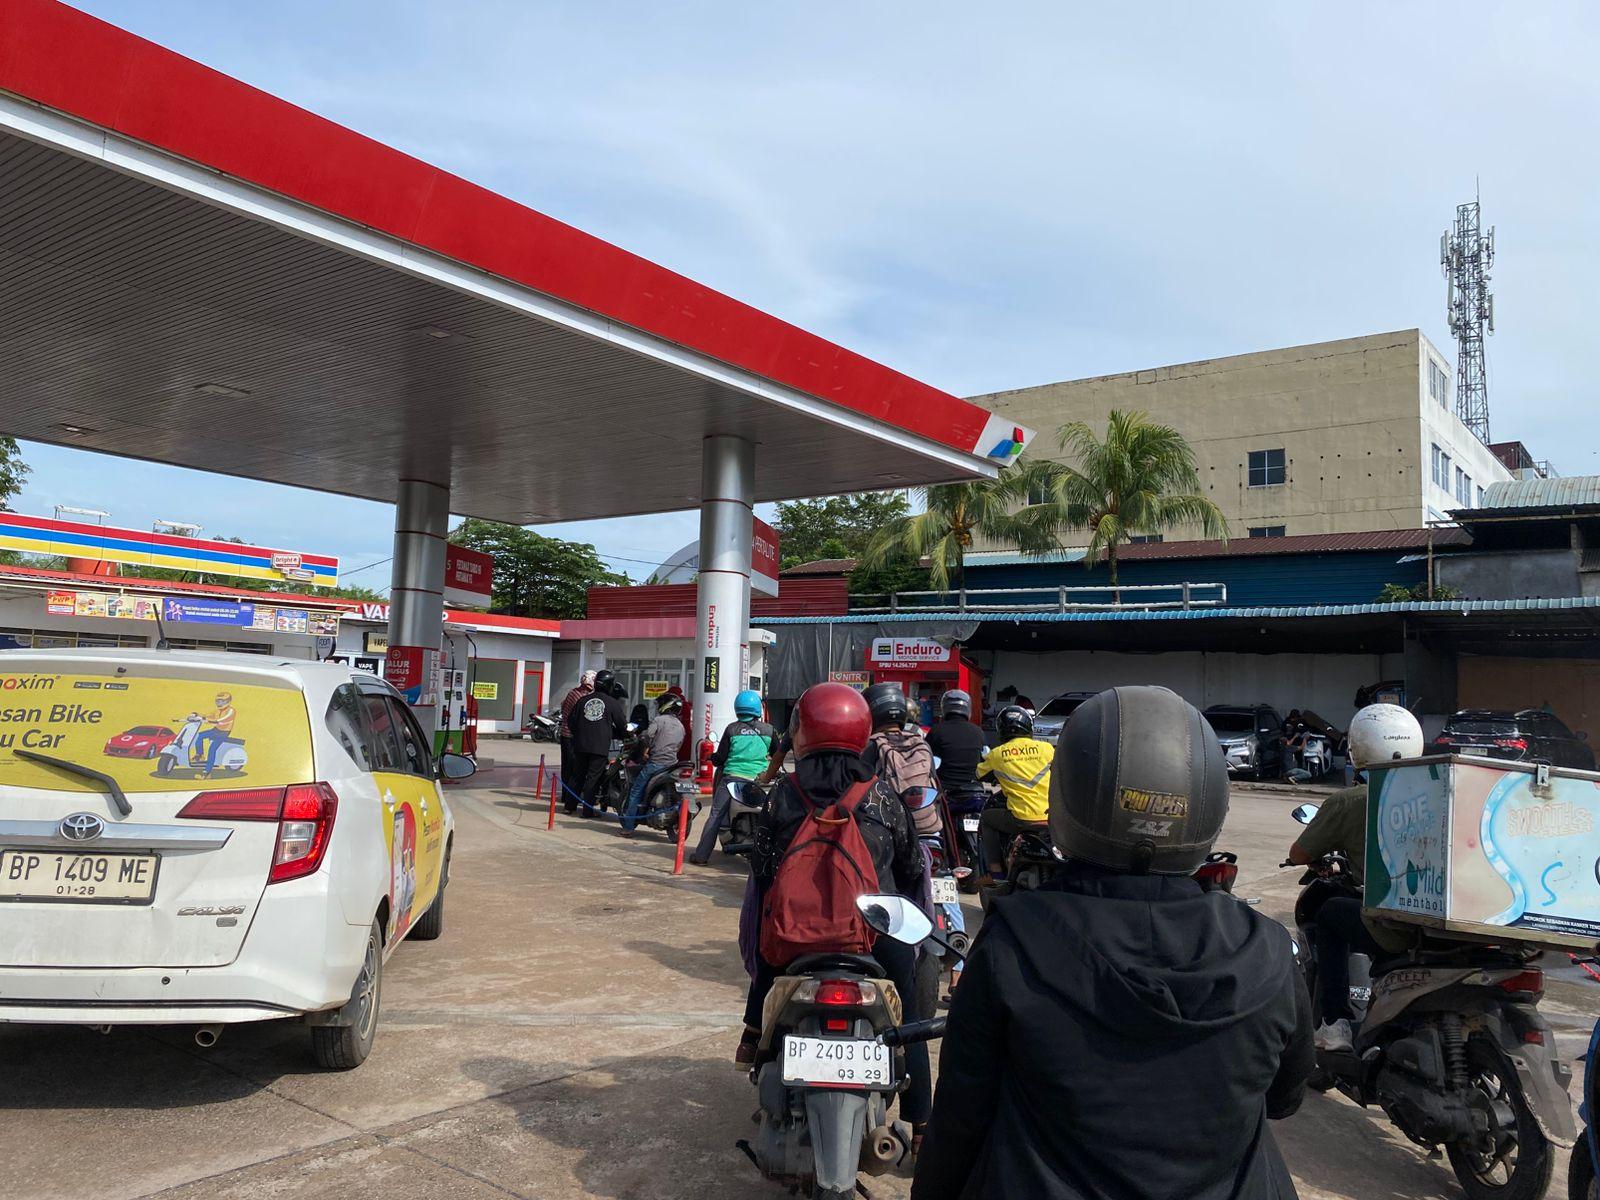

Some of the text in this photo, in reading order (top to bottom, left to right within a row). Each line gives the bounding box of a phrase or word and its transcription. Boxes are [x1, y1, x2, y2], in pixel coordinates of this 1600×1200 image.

[708, 605, 716, 649] Enduro
[896, 643, 942, 656] Enduro
[0, 675, 55, 690] axim
[48, 704, 102, 724] Bike
[22, 728, 66, 748] Car
[741, 728, 761, 736] Grab
[1002, 744, 1039, 757] maxim
[9, 855, 149, 883] BP 1409 ME
[1399, 897, 1443, 912] menthol
[789, 1041, 807, 1058] BP
[816, 1043, 854, 1060] 2403
[865, 1070, 881, 1079] 29
